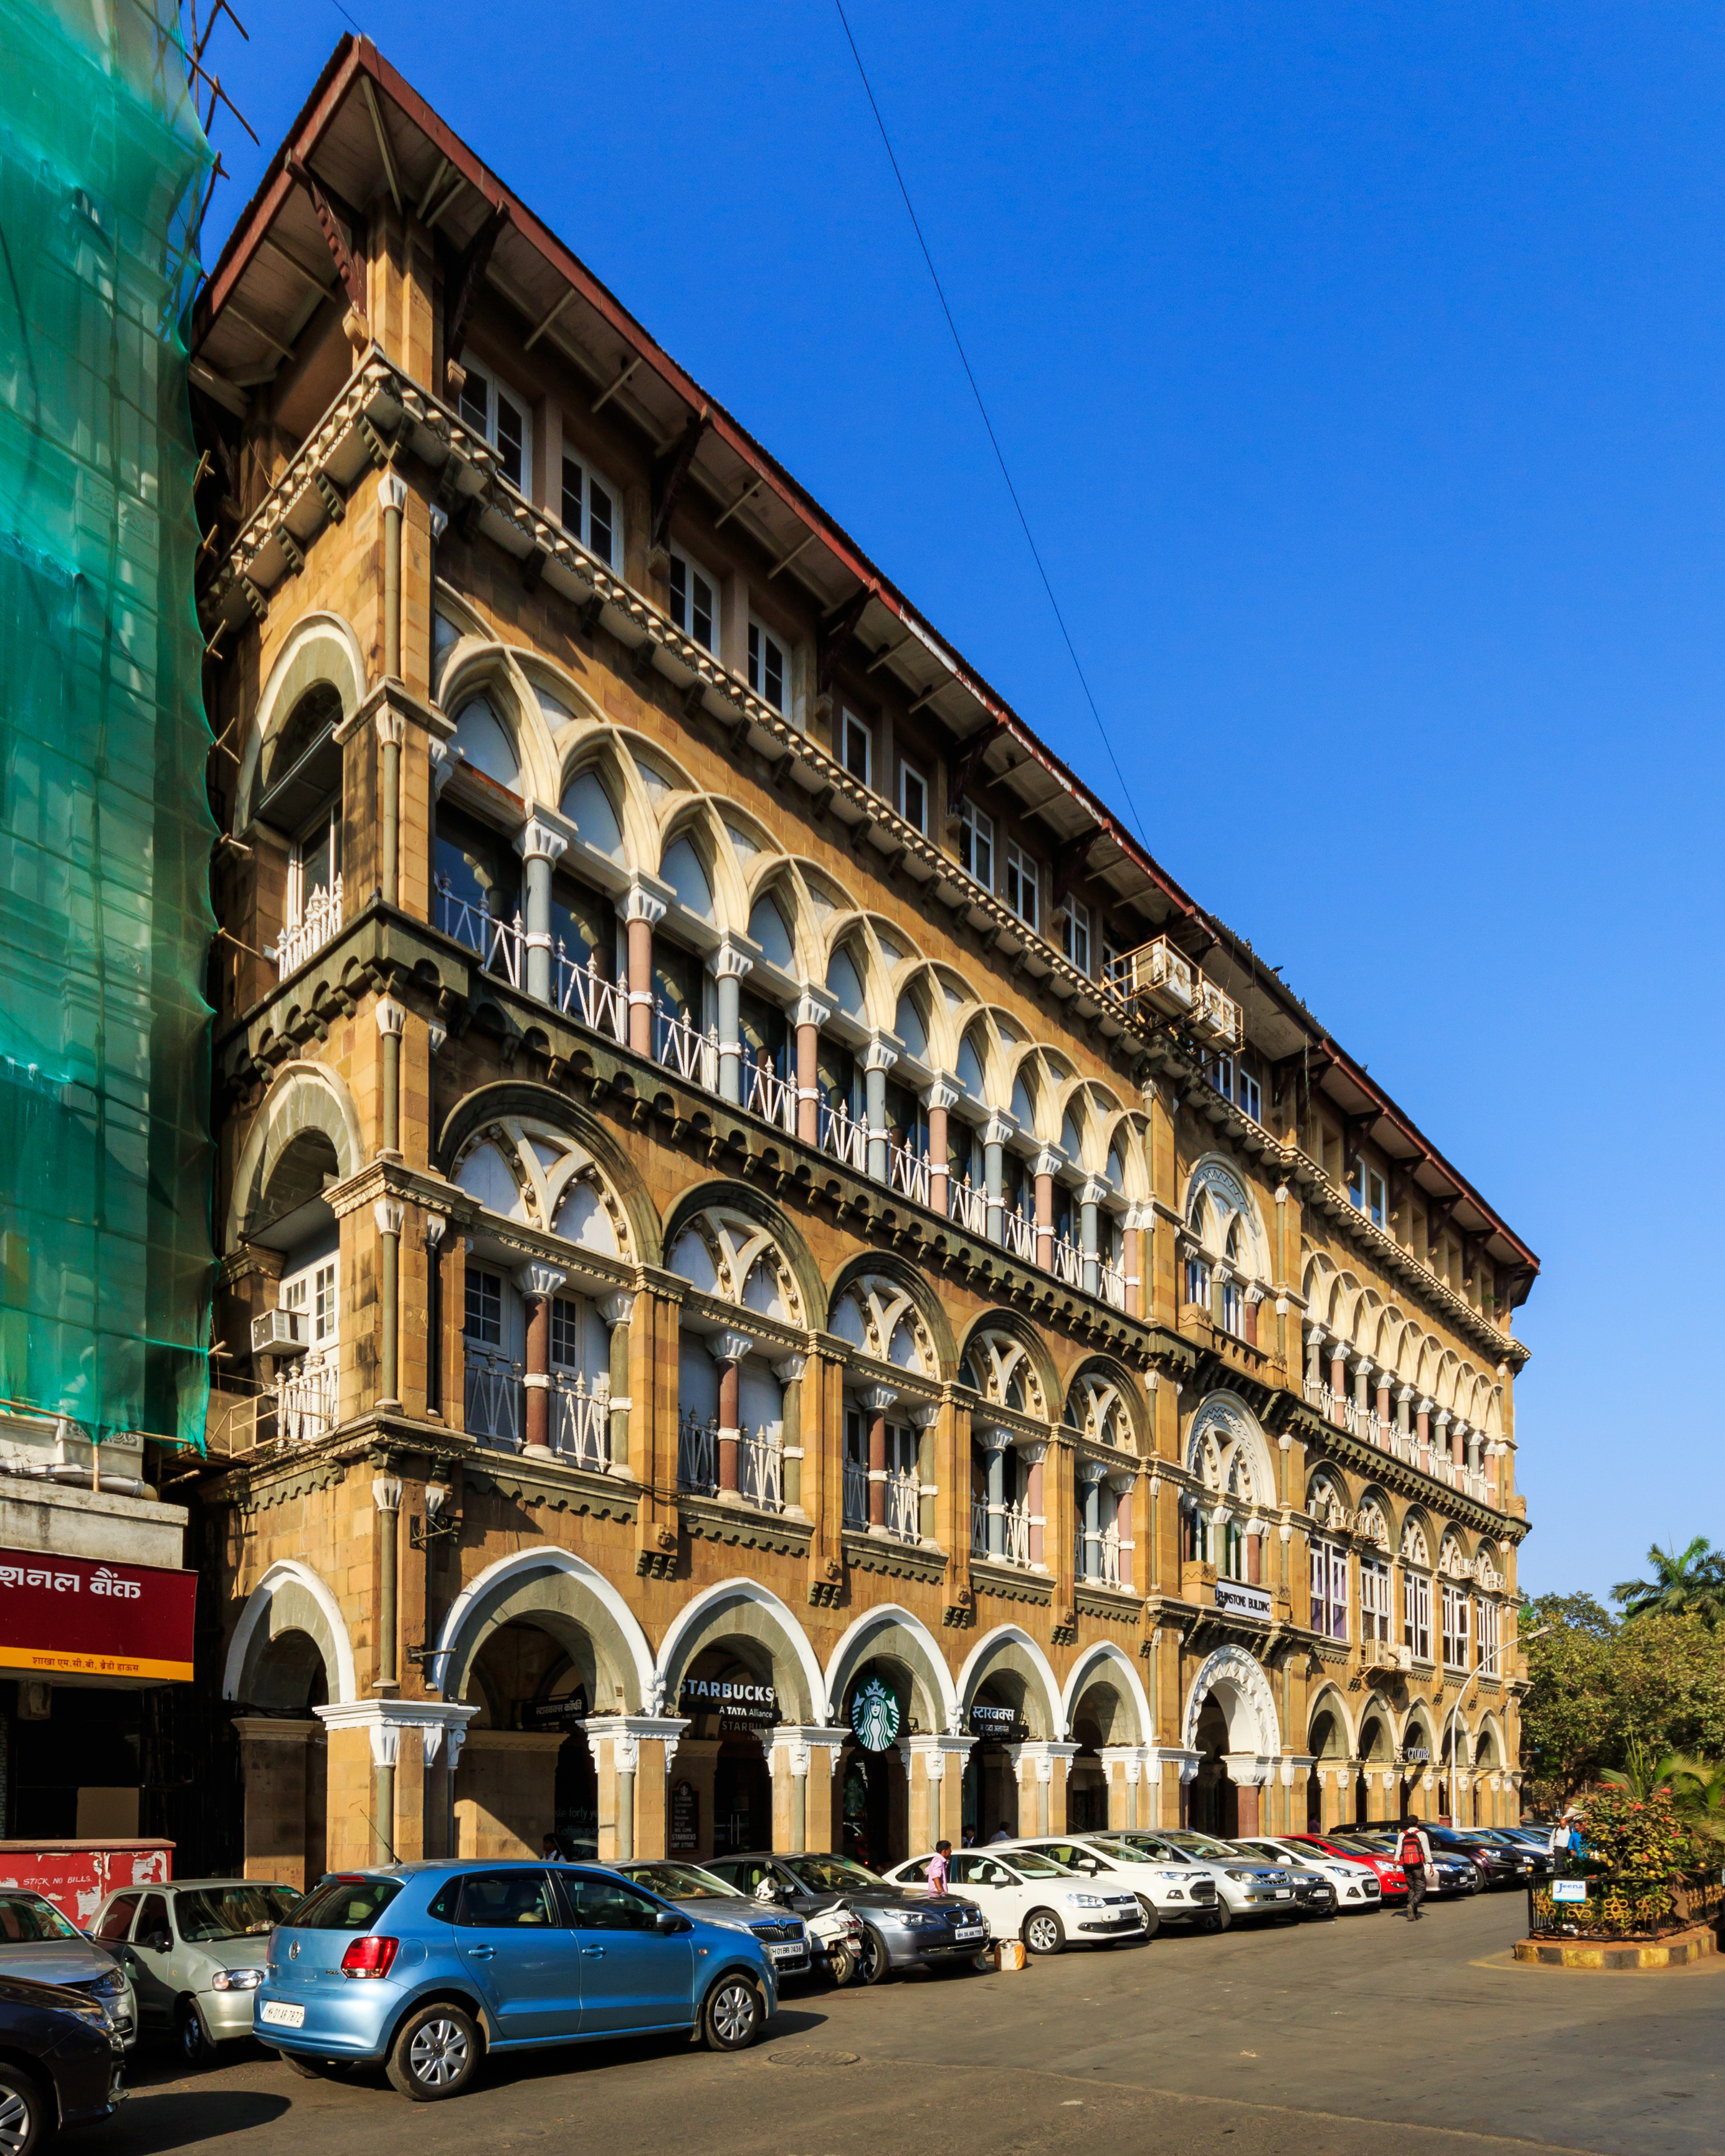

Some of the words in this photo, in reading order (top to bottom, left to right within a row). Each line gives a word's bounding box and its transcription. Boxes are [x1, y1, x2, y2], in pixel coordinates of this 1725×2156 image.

[90, 1567, 141, 1598] बैंक
[1248, 1598, 1270, 1613] BUILDING
[680, 1679, 774, 1702] STARBUCKS
[727, 1706, 747, 1716] TATA
[749, 1709, 773, 1718] Alliance
[972, 1706, 1015, 1721] स्टारबक्स
[721, 1721, 763, 1731] STARBU
[23, 1878, 50, 1887] STICK
[1556, 1883, 1584, 1893] Jeena
